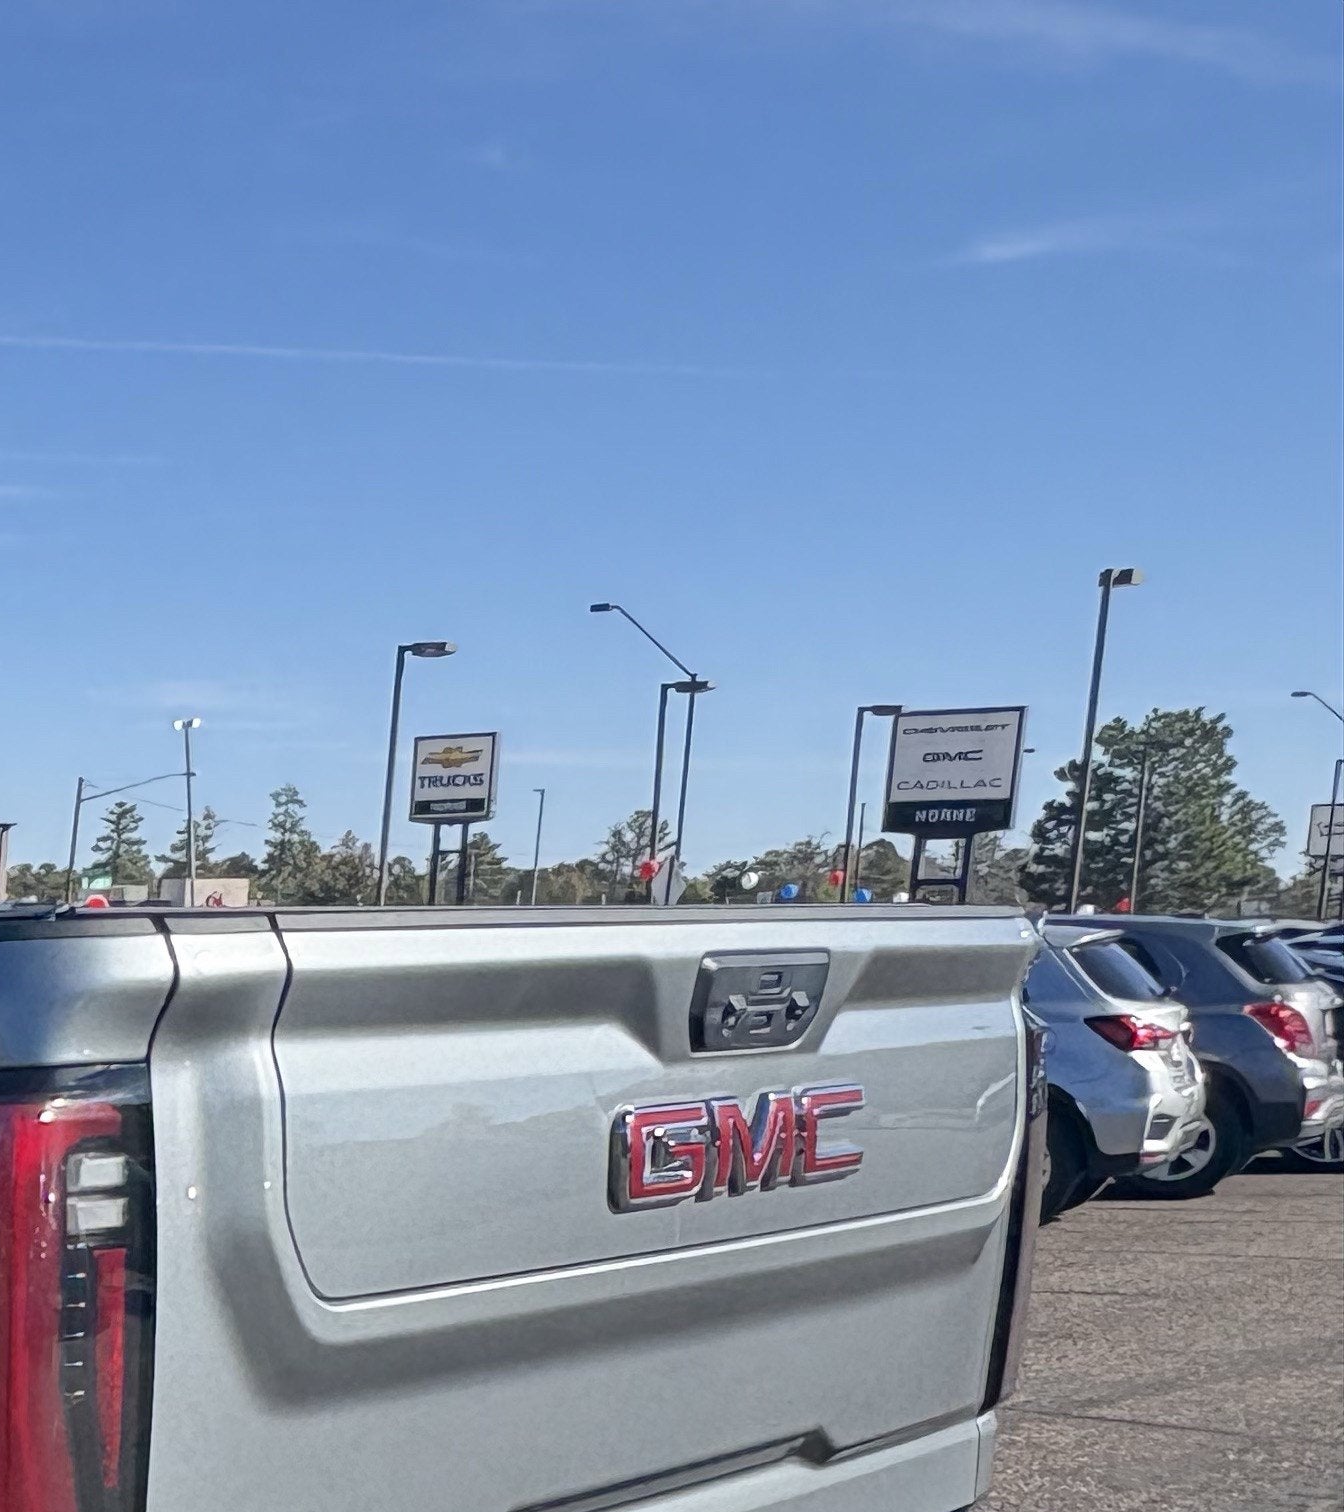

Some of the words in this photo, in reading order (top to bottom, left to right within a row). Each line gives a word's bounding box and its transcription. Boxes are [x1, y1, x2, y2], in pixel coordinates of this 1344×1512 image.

[922, 749, 984, 763] GMC
[417, 773, 485, 789] TRUCKS
[896, 777, 1003, 790] CADILLAC
[608, 1084, 865, 1214] GMC
